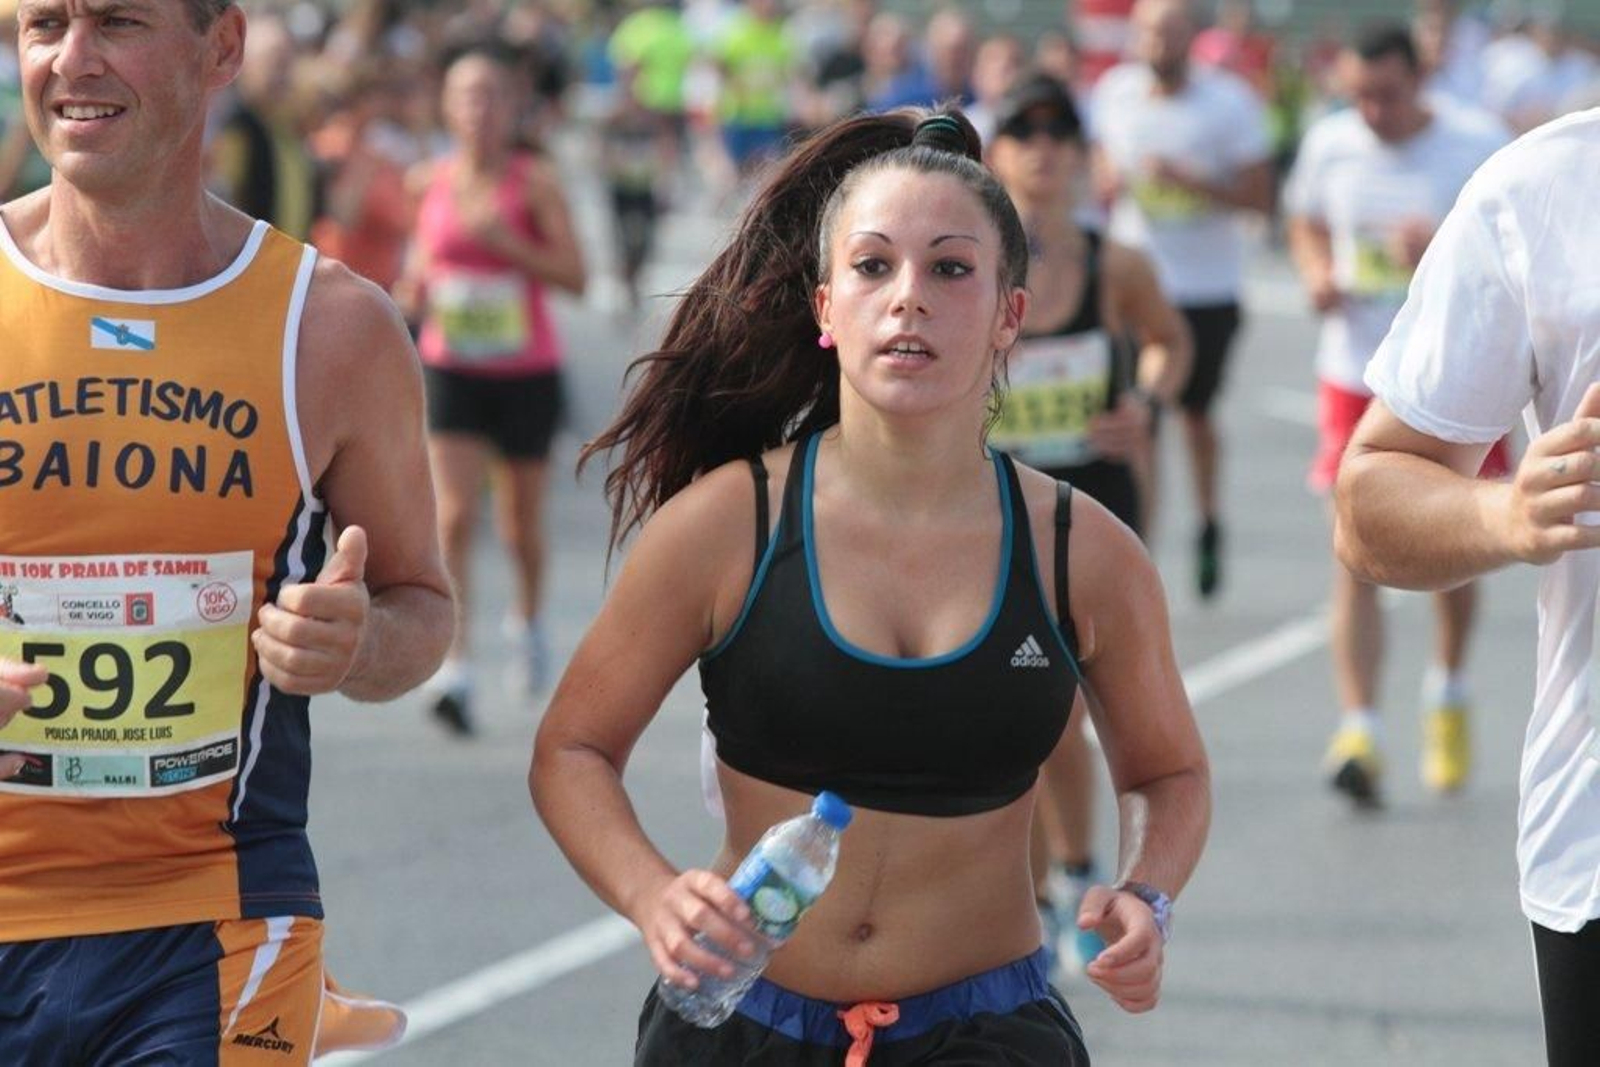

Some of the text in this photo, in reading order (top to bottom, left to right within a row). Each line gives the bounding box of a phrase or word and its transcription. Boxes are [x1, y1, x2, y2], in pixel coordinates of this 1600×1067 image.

[0, 377, 258, 439] ATLETISMO
[0, 441, 253, 498] BAIONA
[21, 562, 53, 579] 10K
[59, 562, 119, 578] PRAIA
[124, 561, 148, 577] DE
[153, 560, 210, 576] SAMIL
[62, 600, 120, 609] CONCELLO
[204, 591, 228, 605] 10K
[69, 611, 114, 620] DE VIGO
[205, 604, 231, 615] VIGO
[1010, 655, 1050, 667] adidas
[22, 641, 195, 720] 592
[45, 727, 78, 740] POUSA
[123, 728, 147, 741] JOSE
[150, 726, 172, 740] LUIS
[154, 743, 233, 771] POWERADE
[232, 1034, 295, 1055] MERCURY
